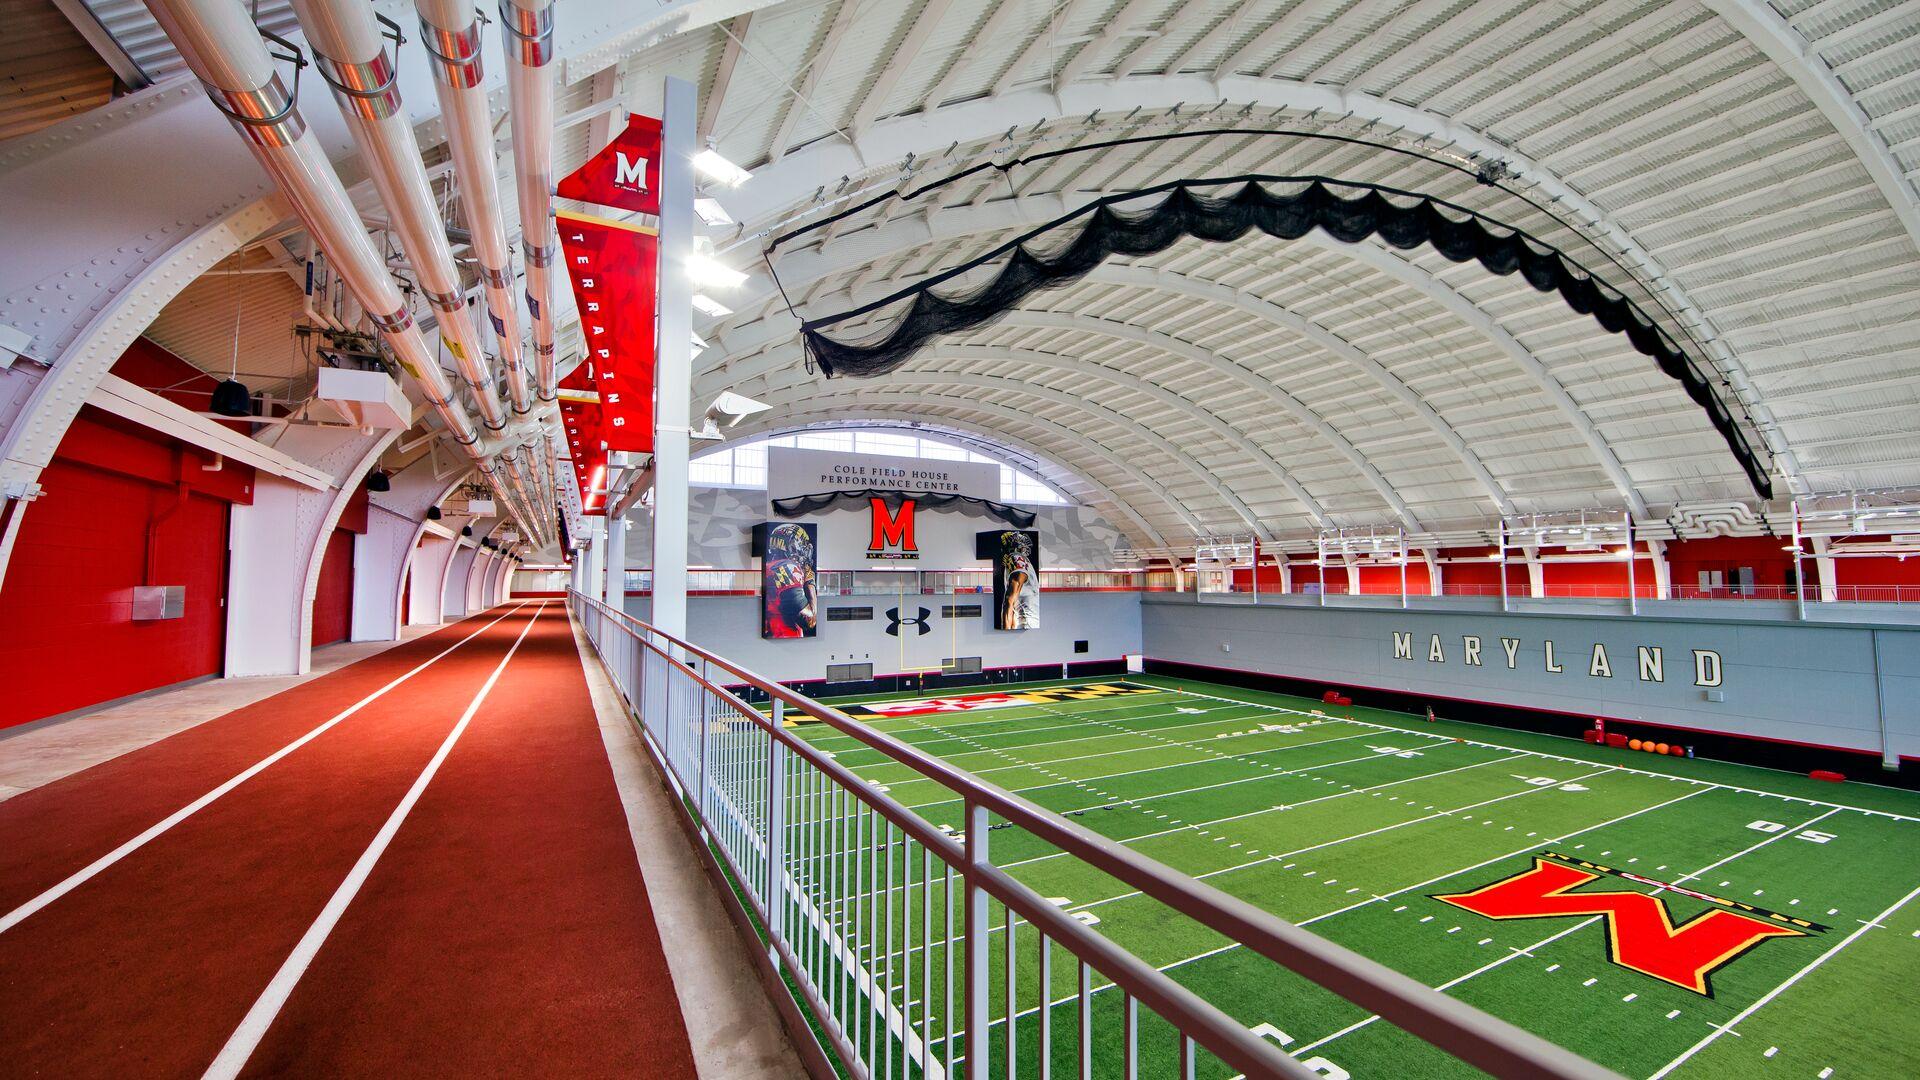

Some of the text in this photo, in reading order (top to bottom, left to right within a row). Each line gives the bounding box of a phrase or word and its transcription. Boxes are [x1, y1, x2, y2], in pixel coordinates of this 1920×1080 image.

[614, 151, 649, 190] M
[572, 233, 625, 427] TERRAPINS
[565, 405, 591, 492] TERRAPIN
[834, 465, 949, 481] COLE FIELD HOUSE
[821, 474, 960, 491] PERFORMANCE CENTER
[868, 497, 919, 551] M
[1392, 631, 1723, 688] MARYLAND
